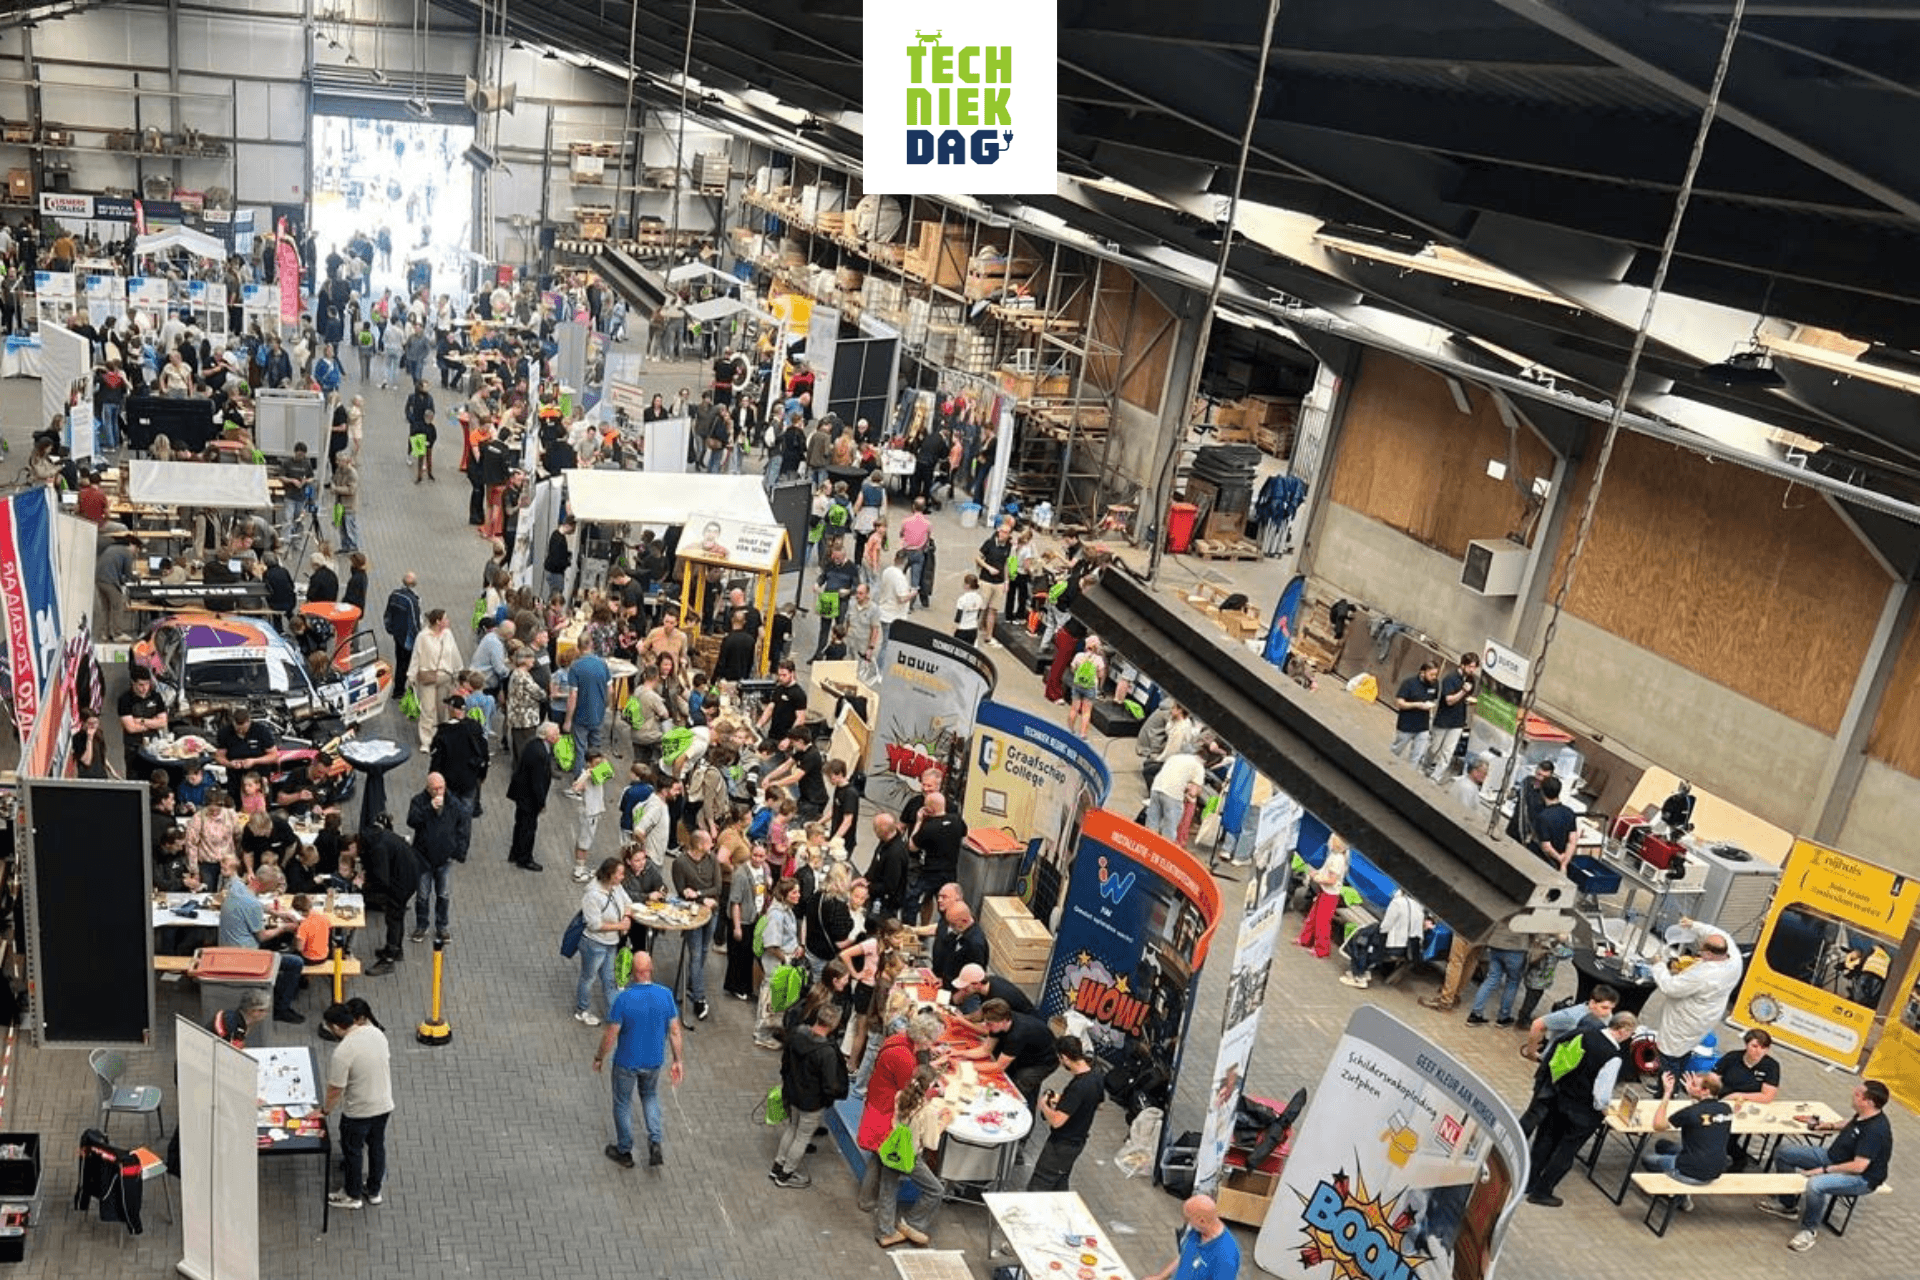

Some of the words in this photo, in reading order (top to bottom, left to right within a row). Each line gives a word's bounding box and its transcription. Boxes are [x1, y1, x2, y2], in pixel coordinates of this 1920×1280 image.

[898, 651, 939, 675] bouw
[1005, 760, 1045, 787] College
[1007, 745, 1066, 784] Graafschap
[1076, 978, 1150, 1036] WOW!
[1341, 1068, 1380, 1099] Zutphen
[1348, 1051, 1437, 1122] Schildersvakopleiding
